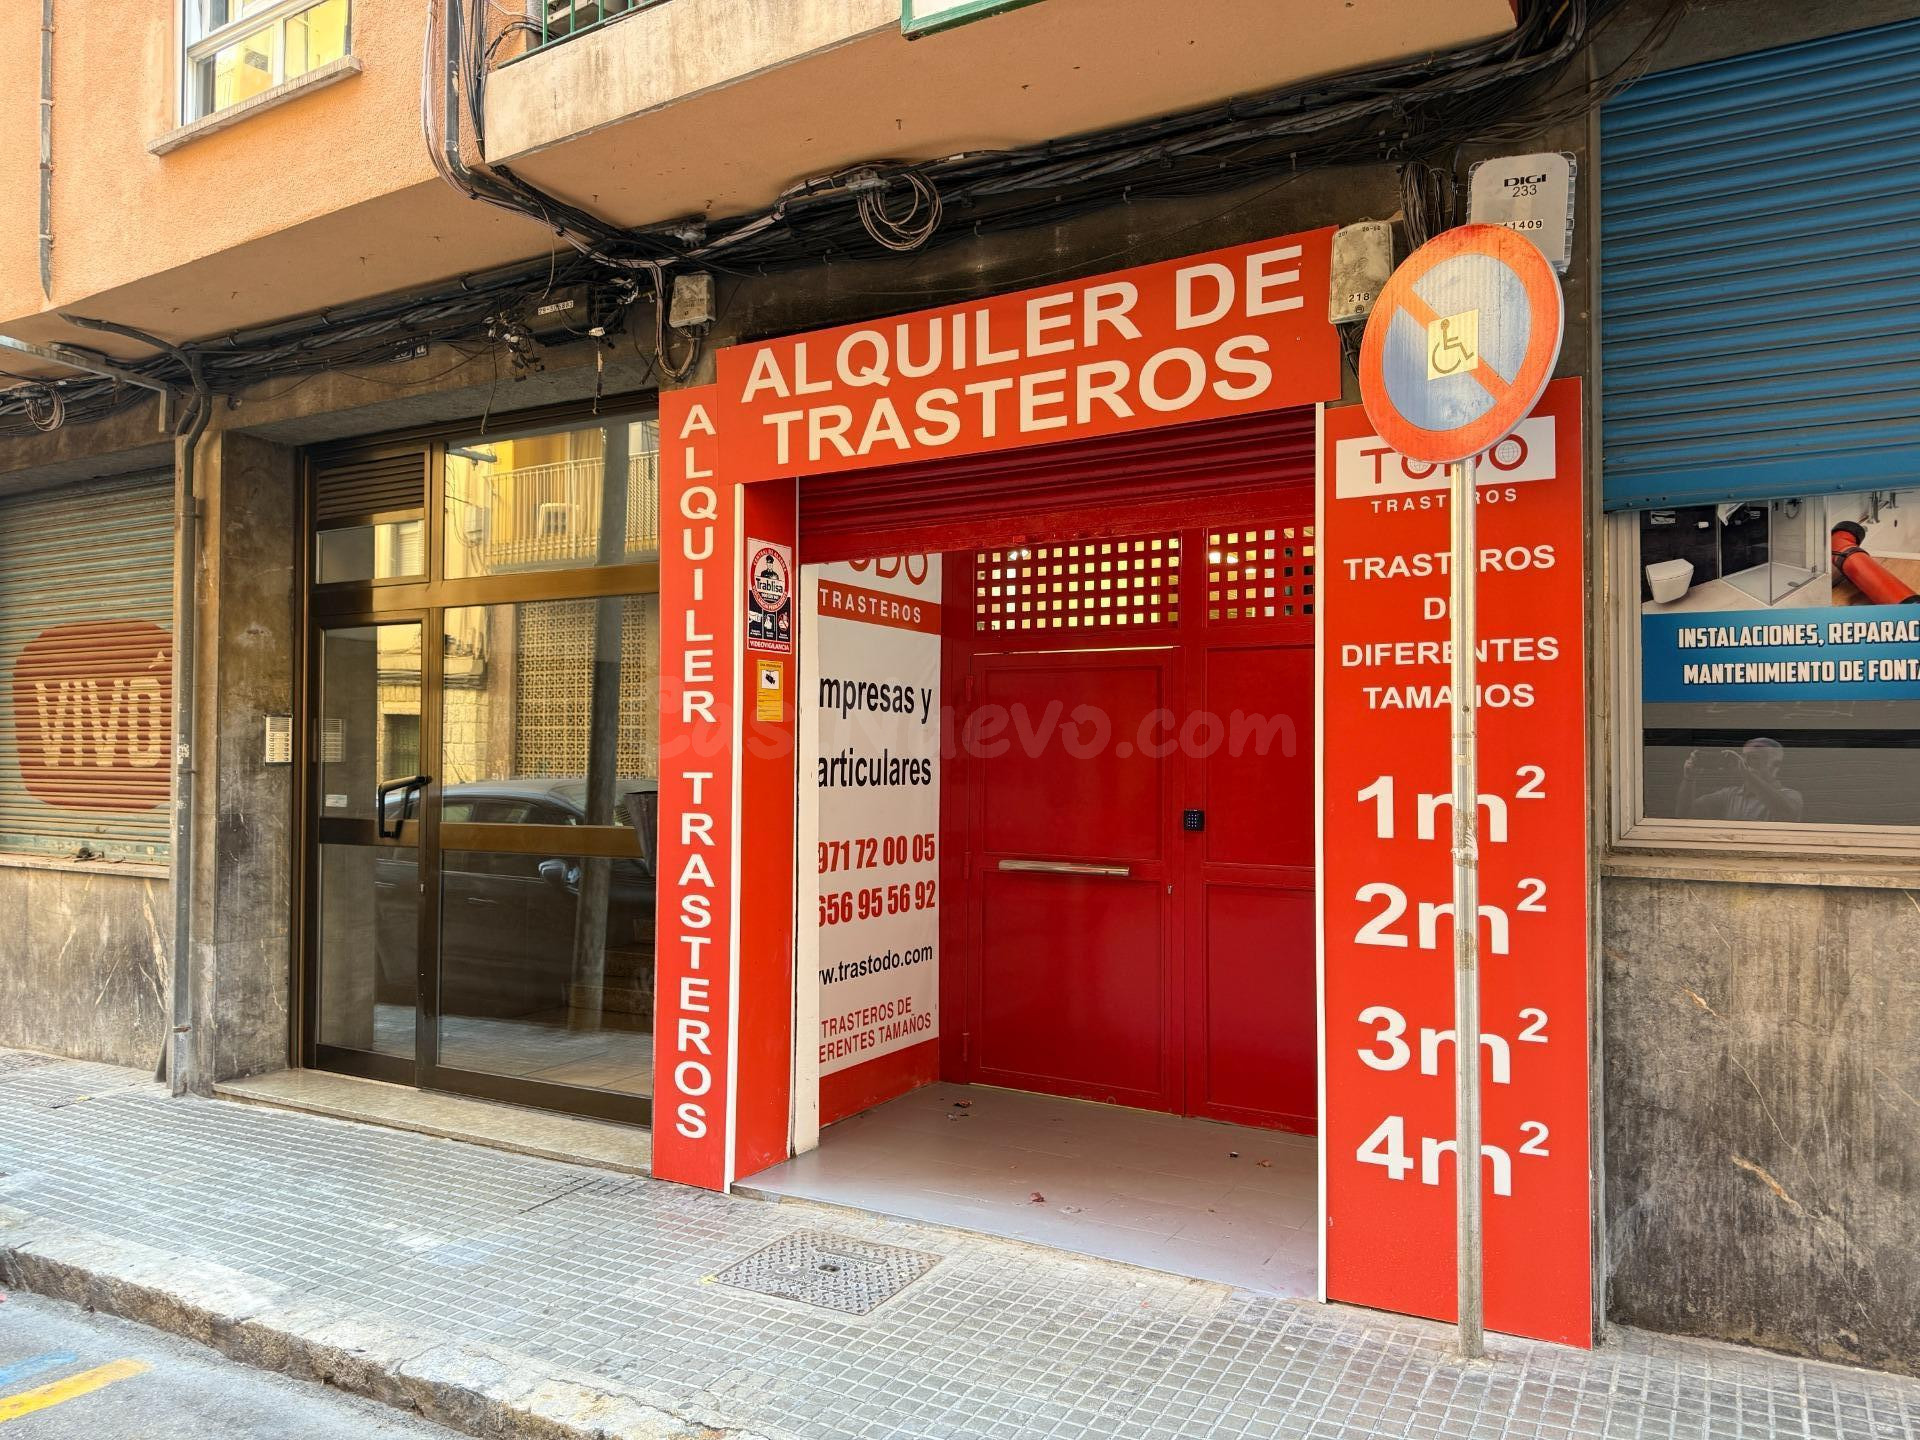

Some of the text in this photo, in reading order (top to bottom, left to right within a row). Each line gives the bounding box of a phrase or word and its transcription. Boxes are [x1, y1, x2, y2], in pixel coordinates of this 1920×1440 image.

[1504, 174, 1546, 187] DIGI
[1512, 184, 1537, 197] 233
[1348, 293, 1370, 303] 218
[742, 246, 1303, 402] ALQUILER DE
[763, 335, 1272, 464] TRASTEROS
[1371, 488, 1517, 513] TRASTROS
[1344, 545, 1556, 580] TRASTROS
[756, 577, 783, 593] Trablisa
[820, 588, 921, 624] TRASTEROS
[1424, 598, 1452, 620] D
[1678, 620, 1920, 649] INSTALACIONES, REPARAC
[1683, 659, 1920, 685] MANTENIMIENTO DE FONT
[921, 688, 932, 725] y
[1363, 684, 1535, 709] TAMAOS
[675, 405, 717, 1138] ALQUILER TRASTEROS
[855, 837, 878, 869] 72
[883, 835, 908, 866] 00
[912, 833, 935, 863] 05
[858, 887, 883, 920] 95
[887, 883, 911, 915] 56
[915, 880, 936, 910] 92
[819, 944, 933, 986] w.trastodo.com
[822, 996, 912, 1039] TRASTEROS DE
[879, 1012, 931, 1048] TAMAÑOS
